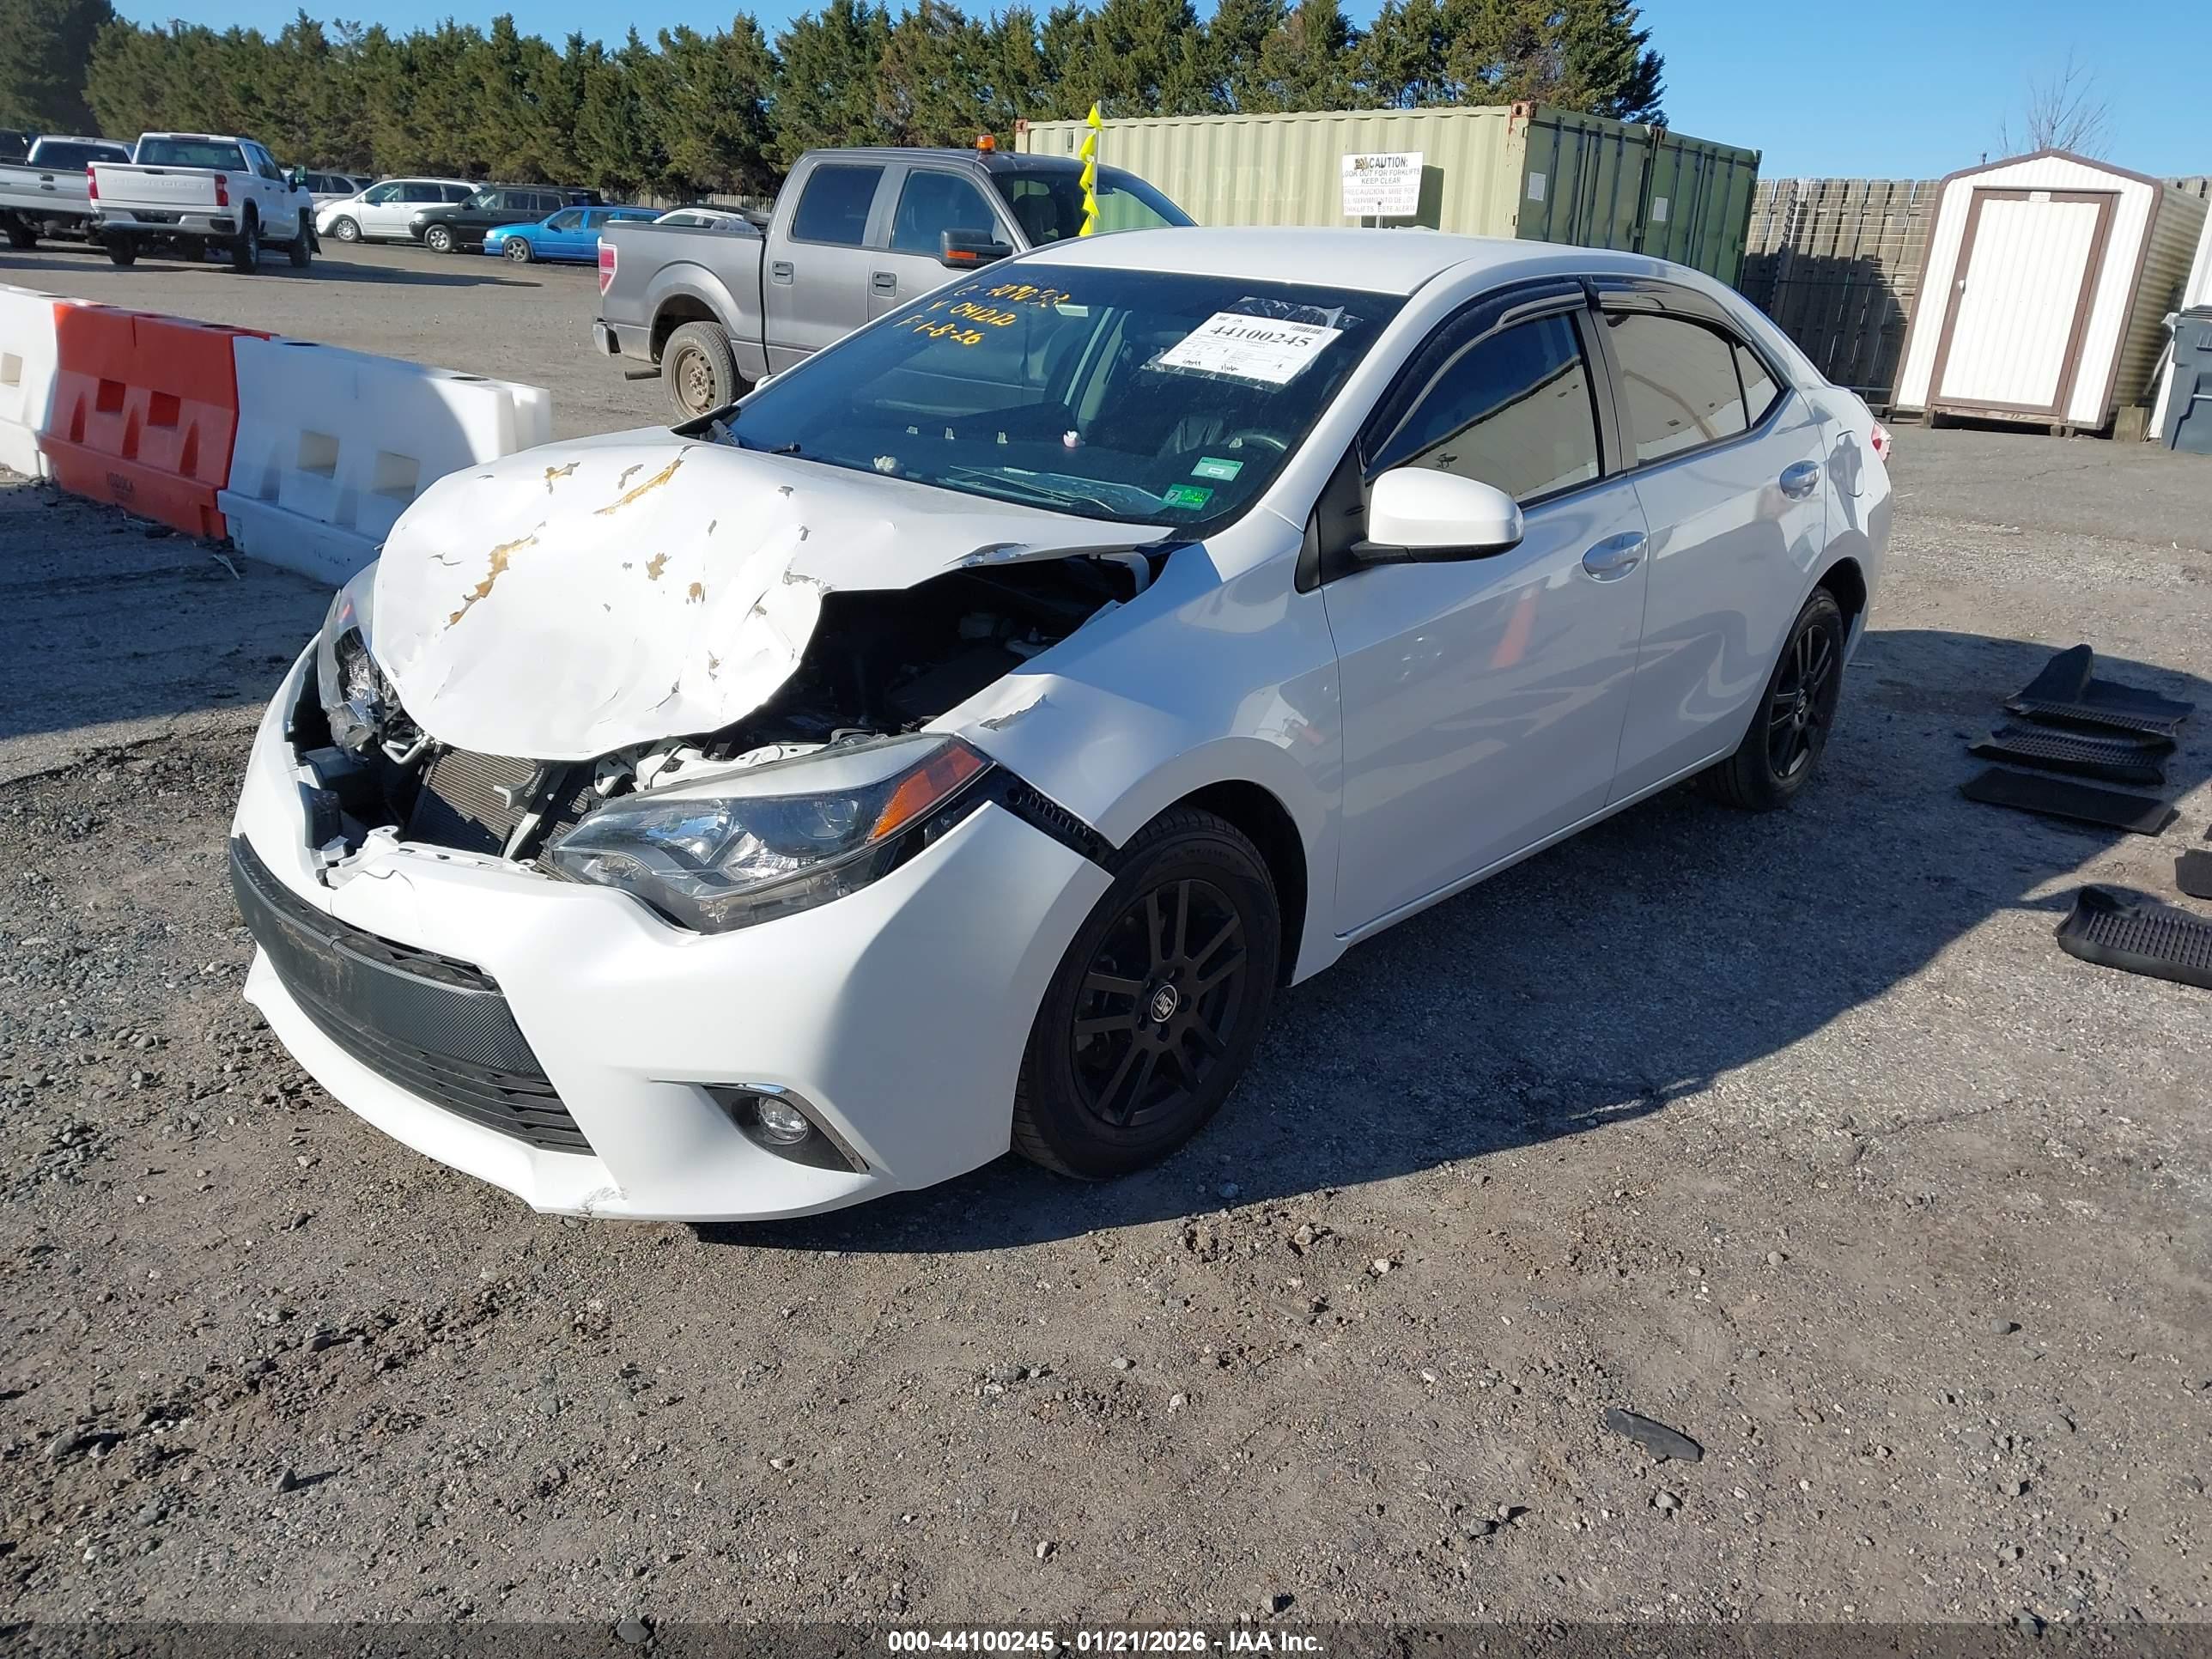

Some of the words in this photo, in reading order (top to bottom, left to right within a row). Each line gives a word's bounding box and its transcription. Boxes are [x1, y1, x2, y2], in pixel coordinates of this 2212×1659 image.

[1369, 156, 1408, 168] CAUTION:
[1389, 167, 1420, 177] FORKLIFTS
[1210, 325, 1314, 348] 44100245
